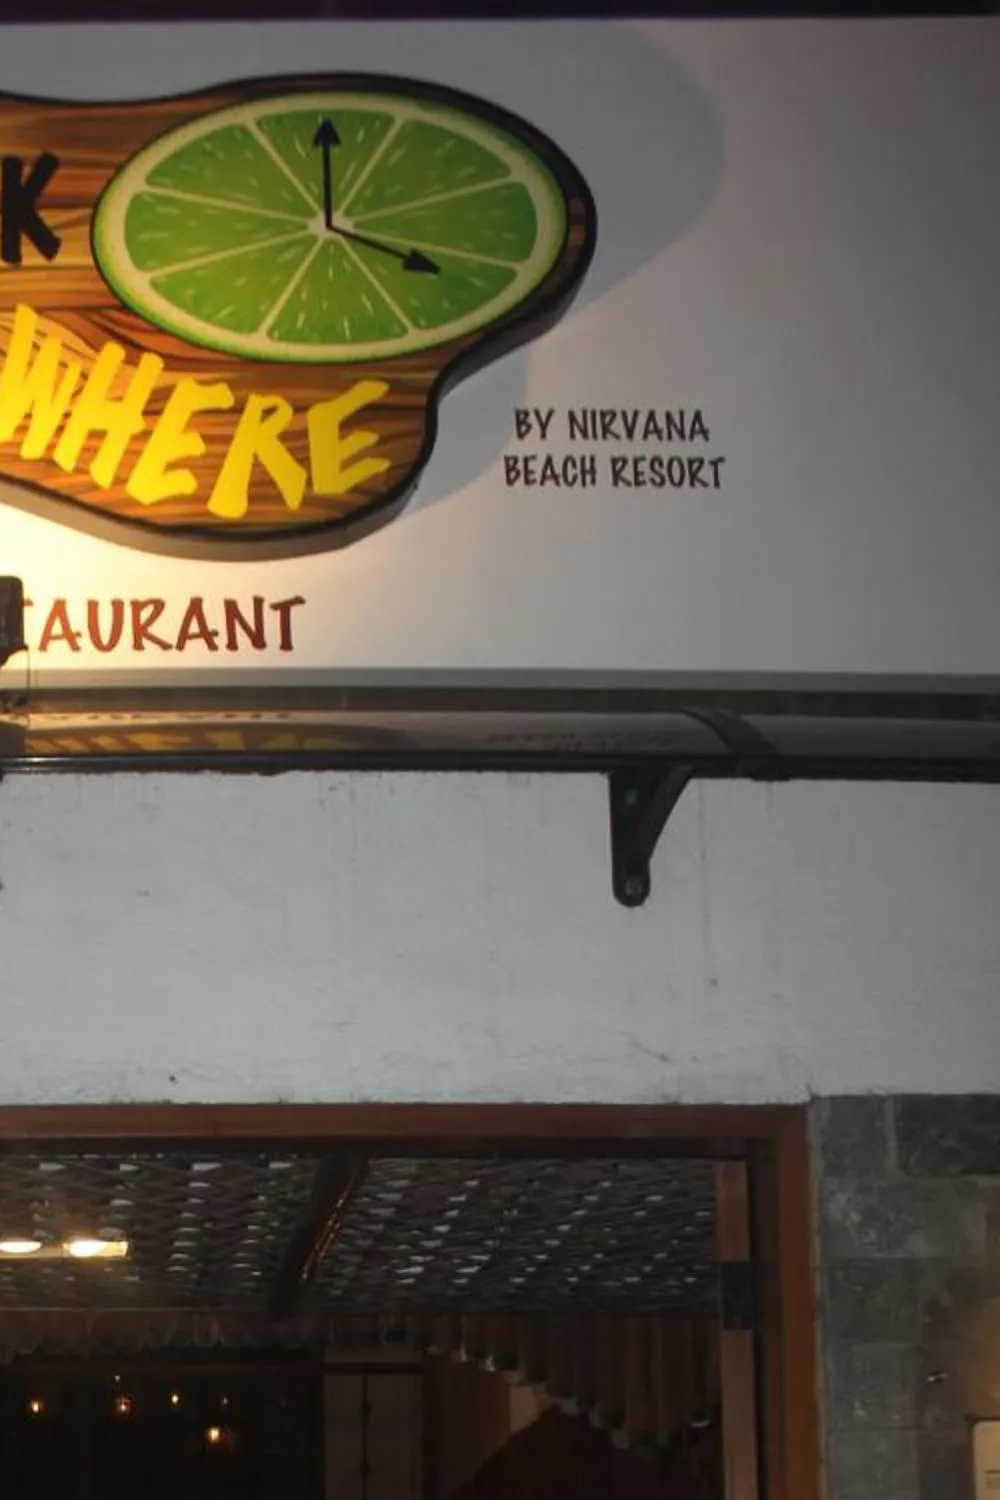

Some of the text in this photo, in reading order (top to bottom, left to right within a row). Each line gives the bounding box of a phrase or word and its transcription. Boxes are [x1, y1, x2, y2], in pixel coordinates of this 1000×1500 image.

[514, 408, 710, 441] BY NIRVANA
[504, 454, 726, 488] BEACH RESORT
